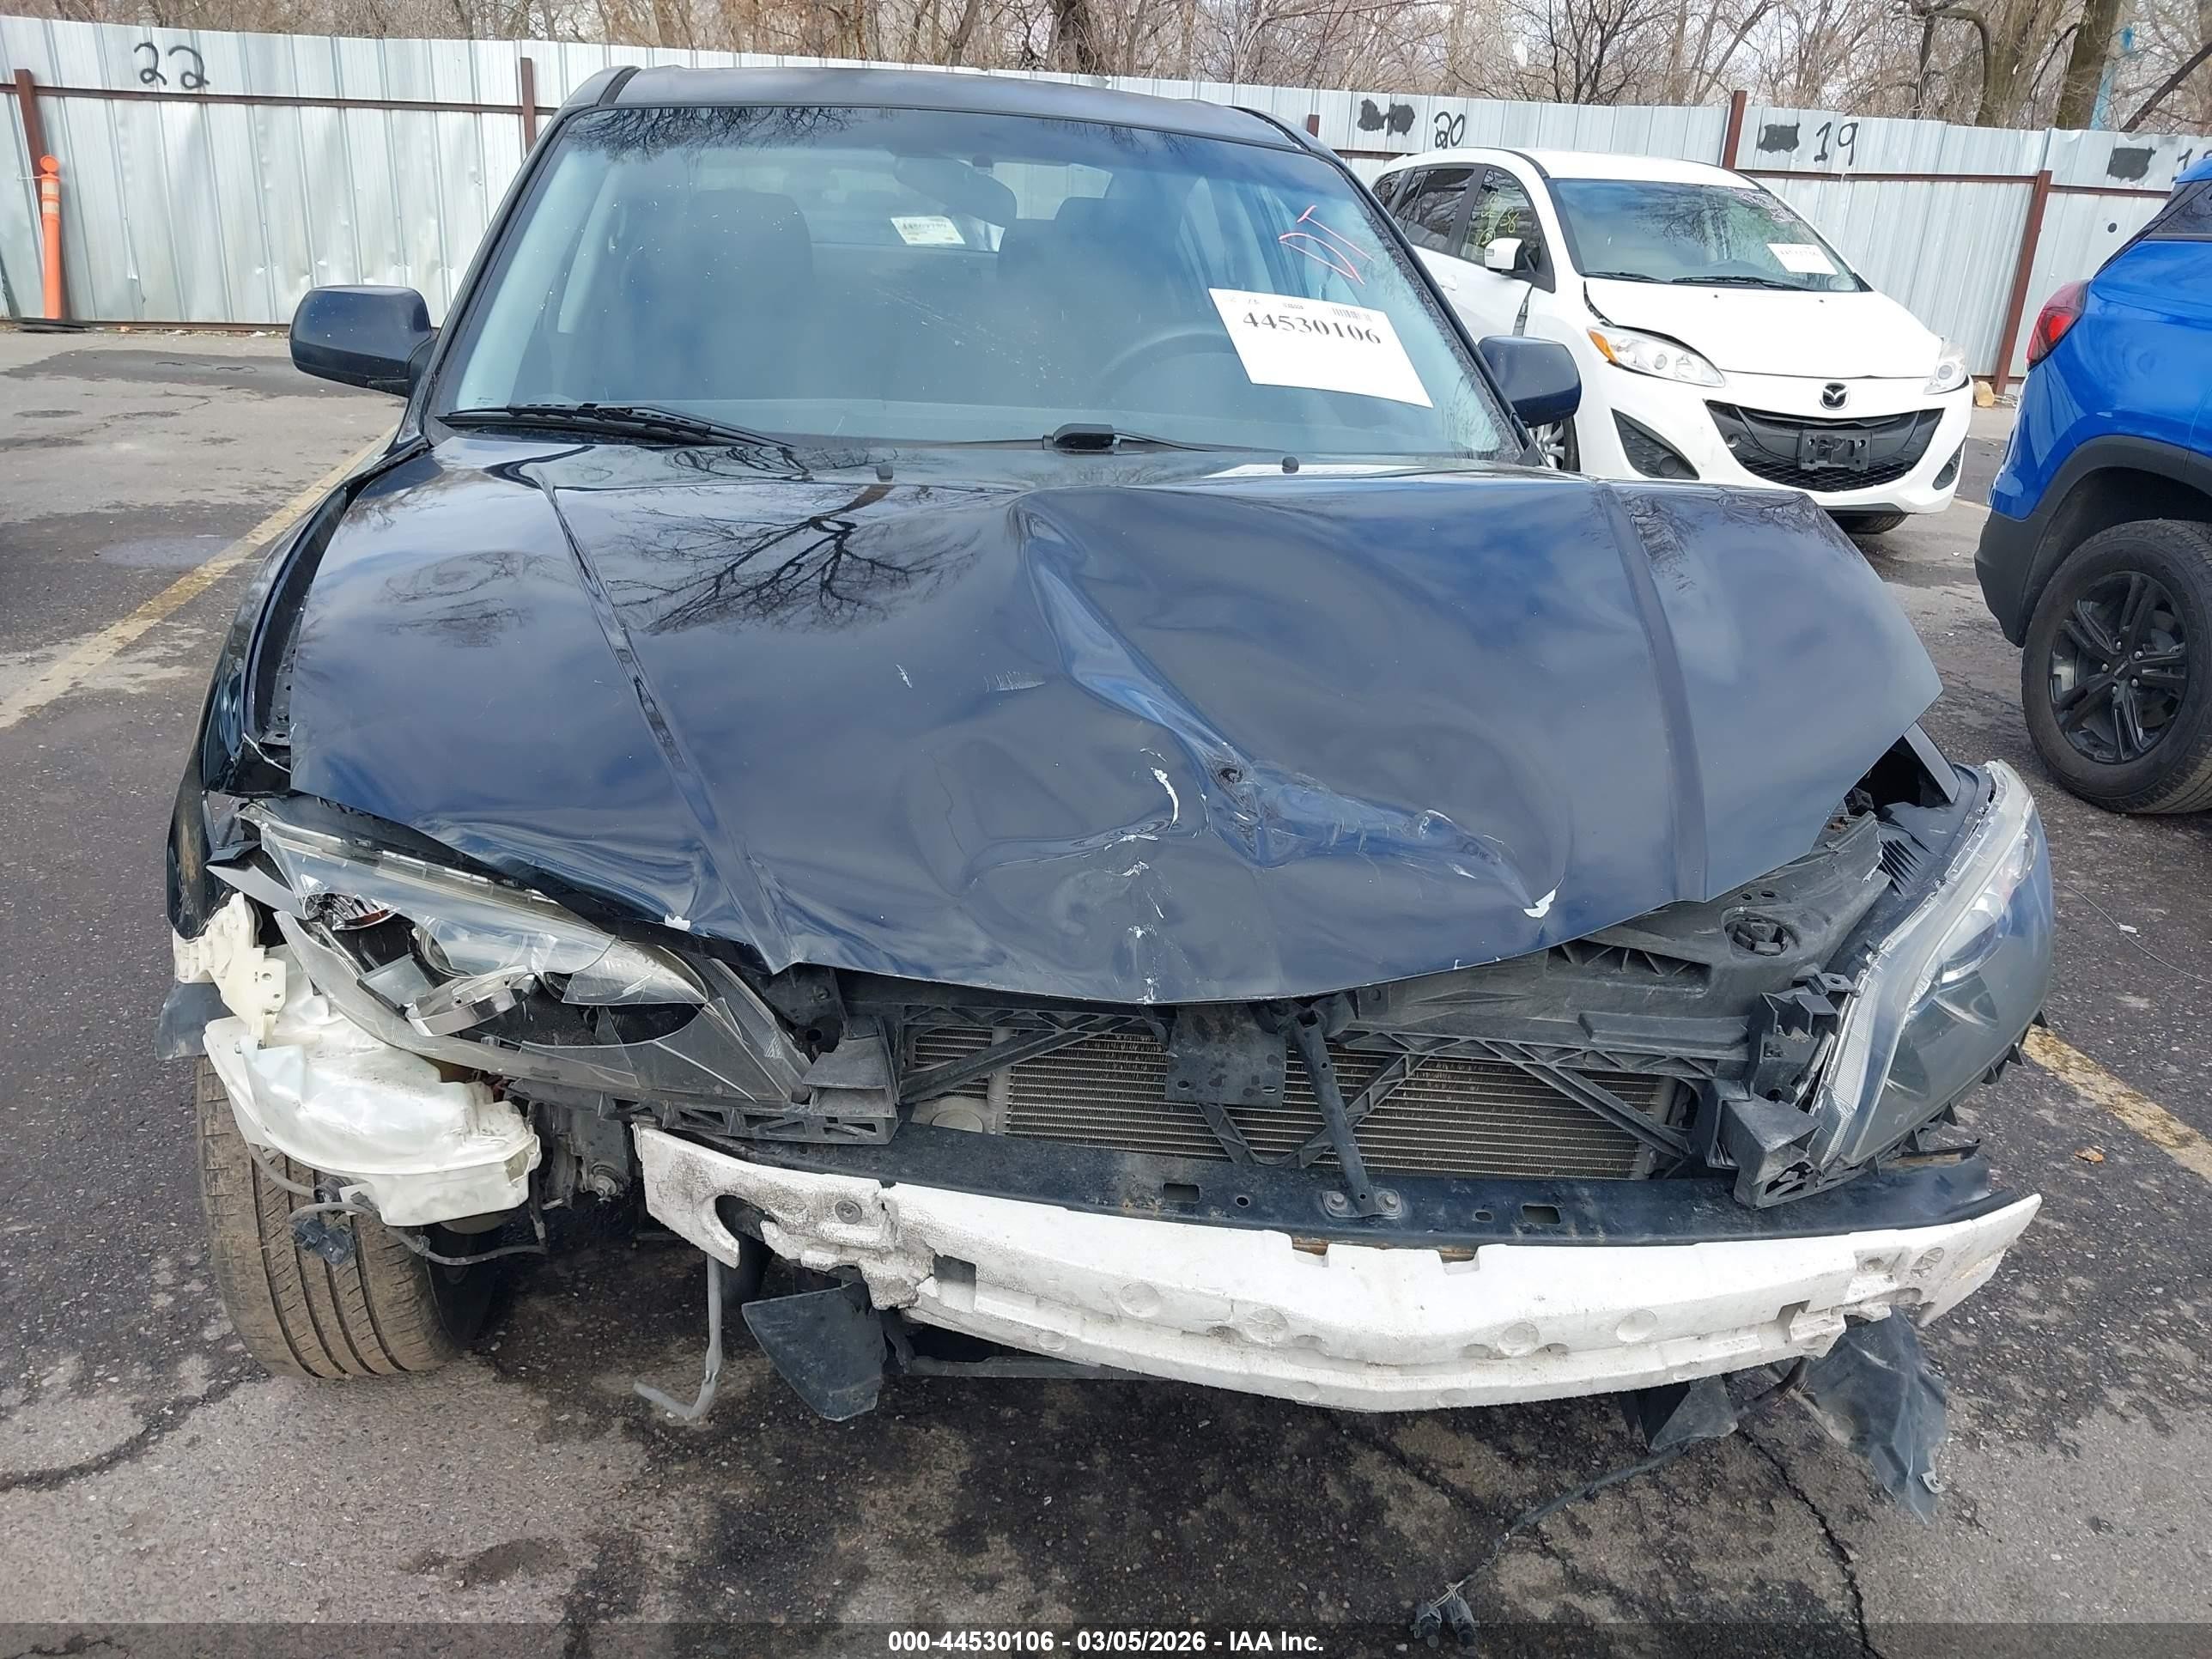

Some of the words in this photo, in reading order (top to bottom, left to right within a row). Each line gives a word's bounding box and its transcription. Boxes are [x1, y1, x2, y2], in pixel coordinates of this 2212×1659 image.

[134, 41, 210, 89] 22
[1434, 111, 1466, 149] 20
[1814, 121, 1859, 167] 19
[1243, 312, 1382, 344] 44530106
